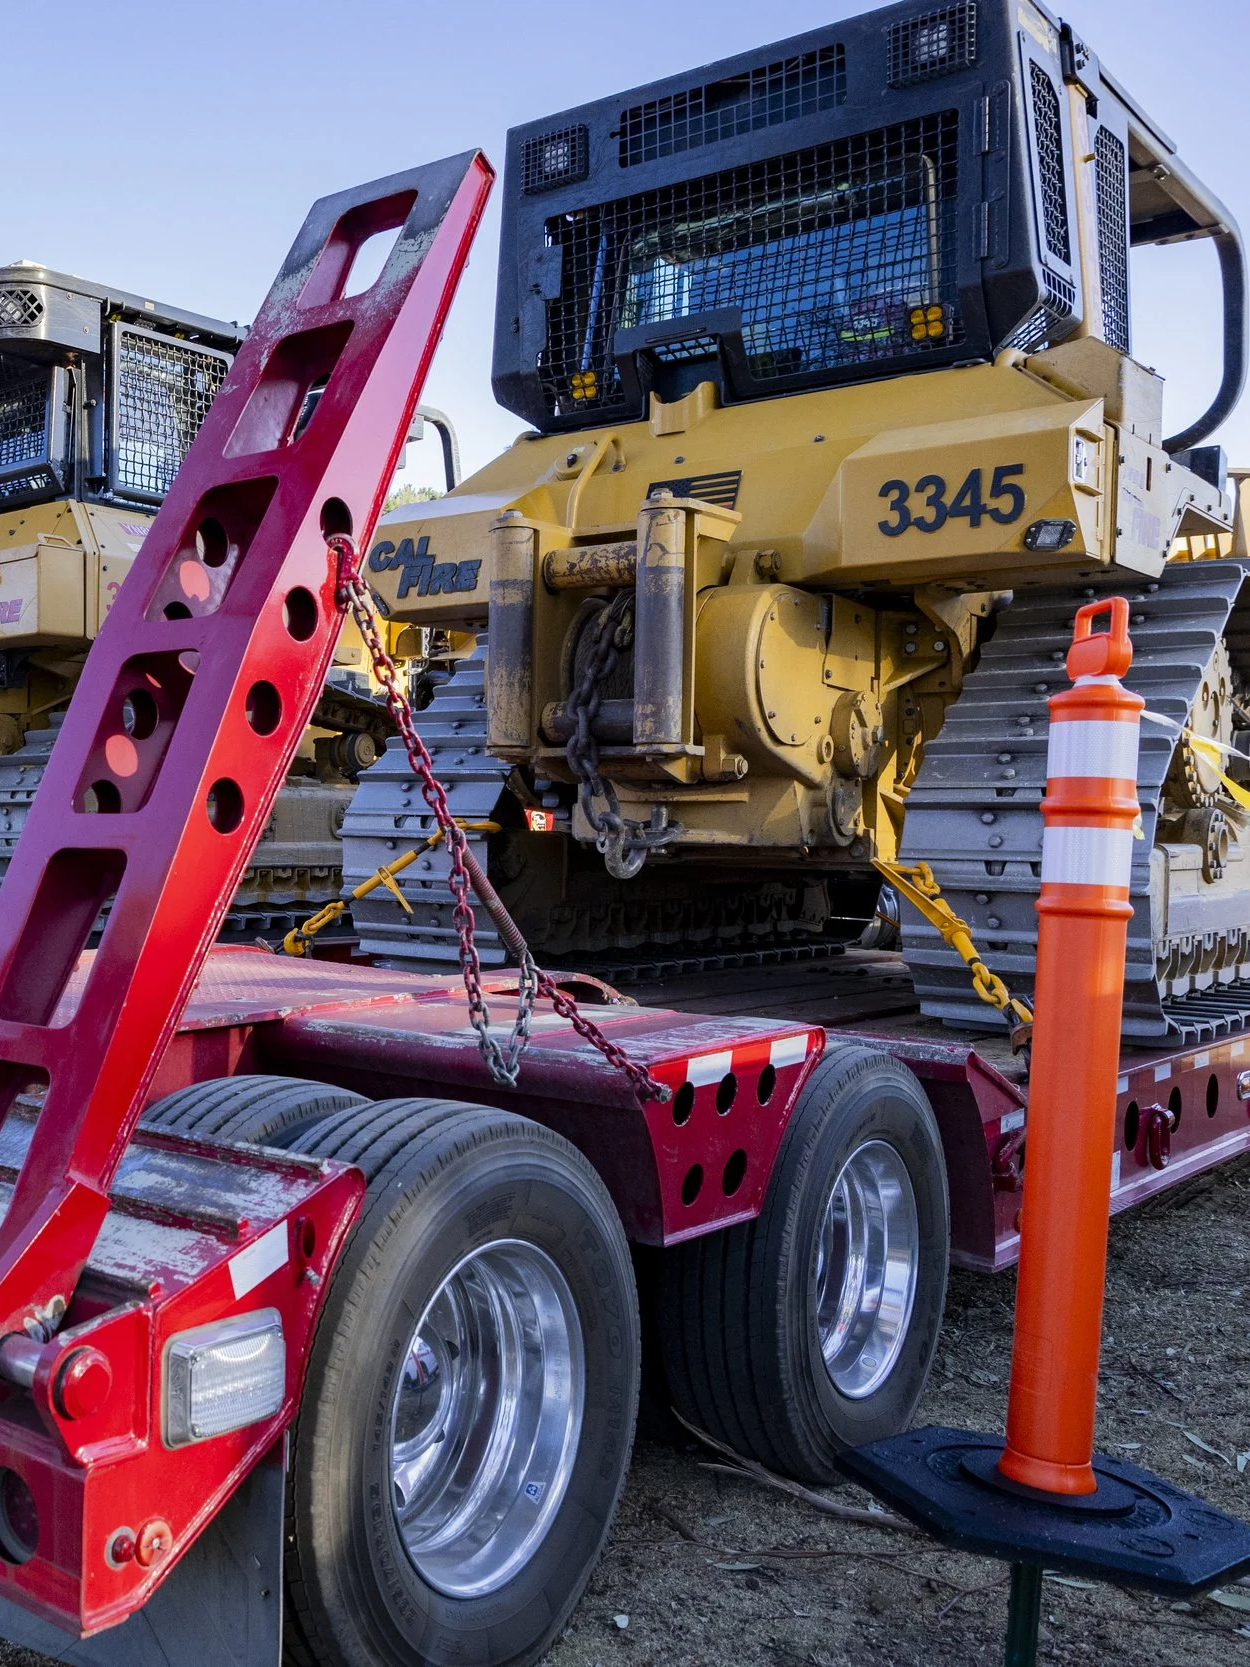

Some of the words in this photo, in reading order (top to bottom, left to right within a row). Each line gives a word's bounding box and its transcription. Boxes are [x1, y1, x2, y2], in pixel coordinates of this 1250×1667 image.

[878, 463, 1026, 537] 3345
[369, 536, 436, 572] CAL
[397, 559, 482, 599] FIRE
